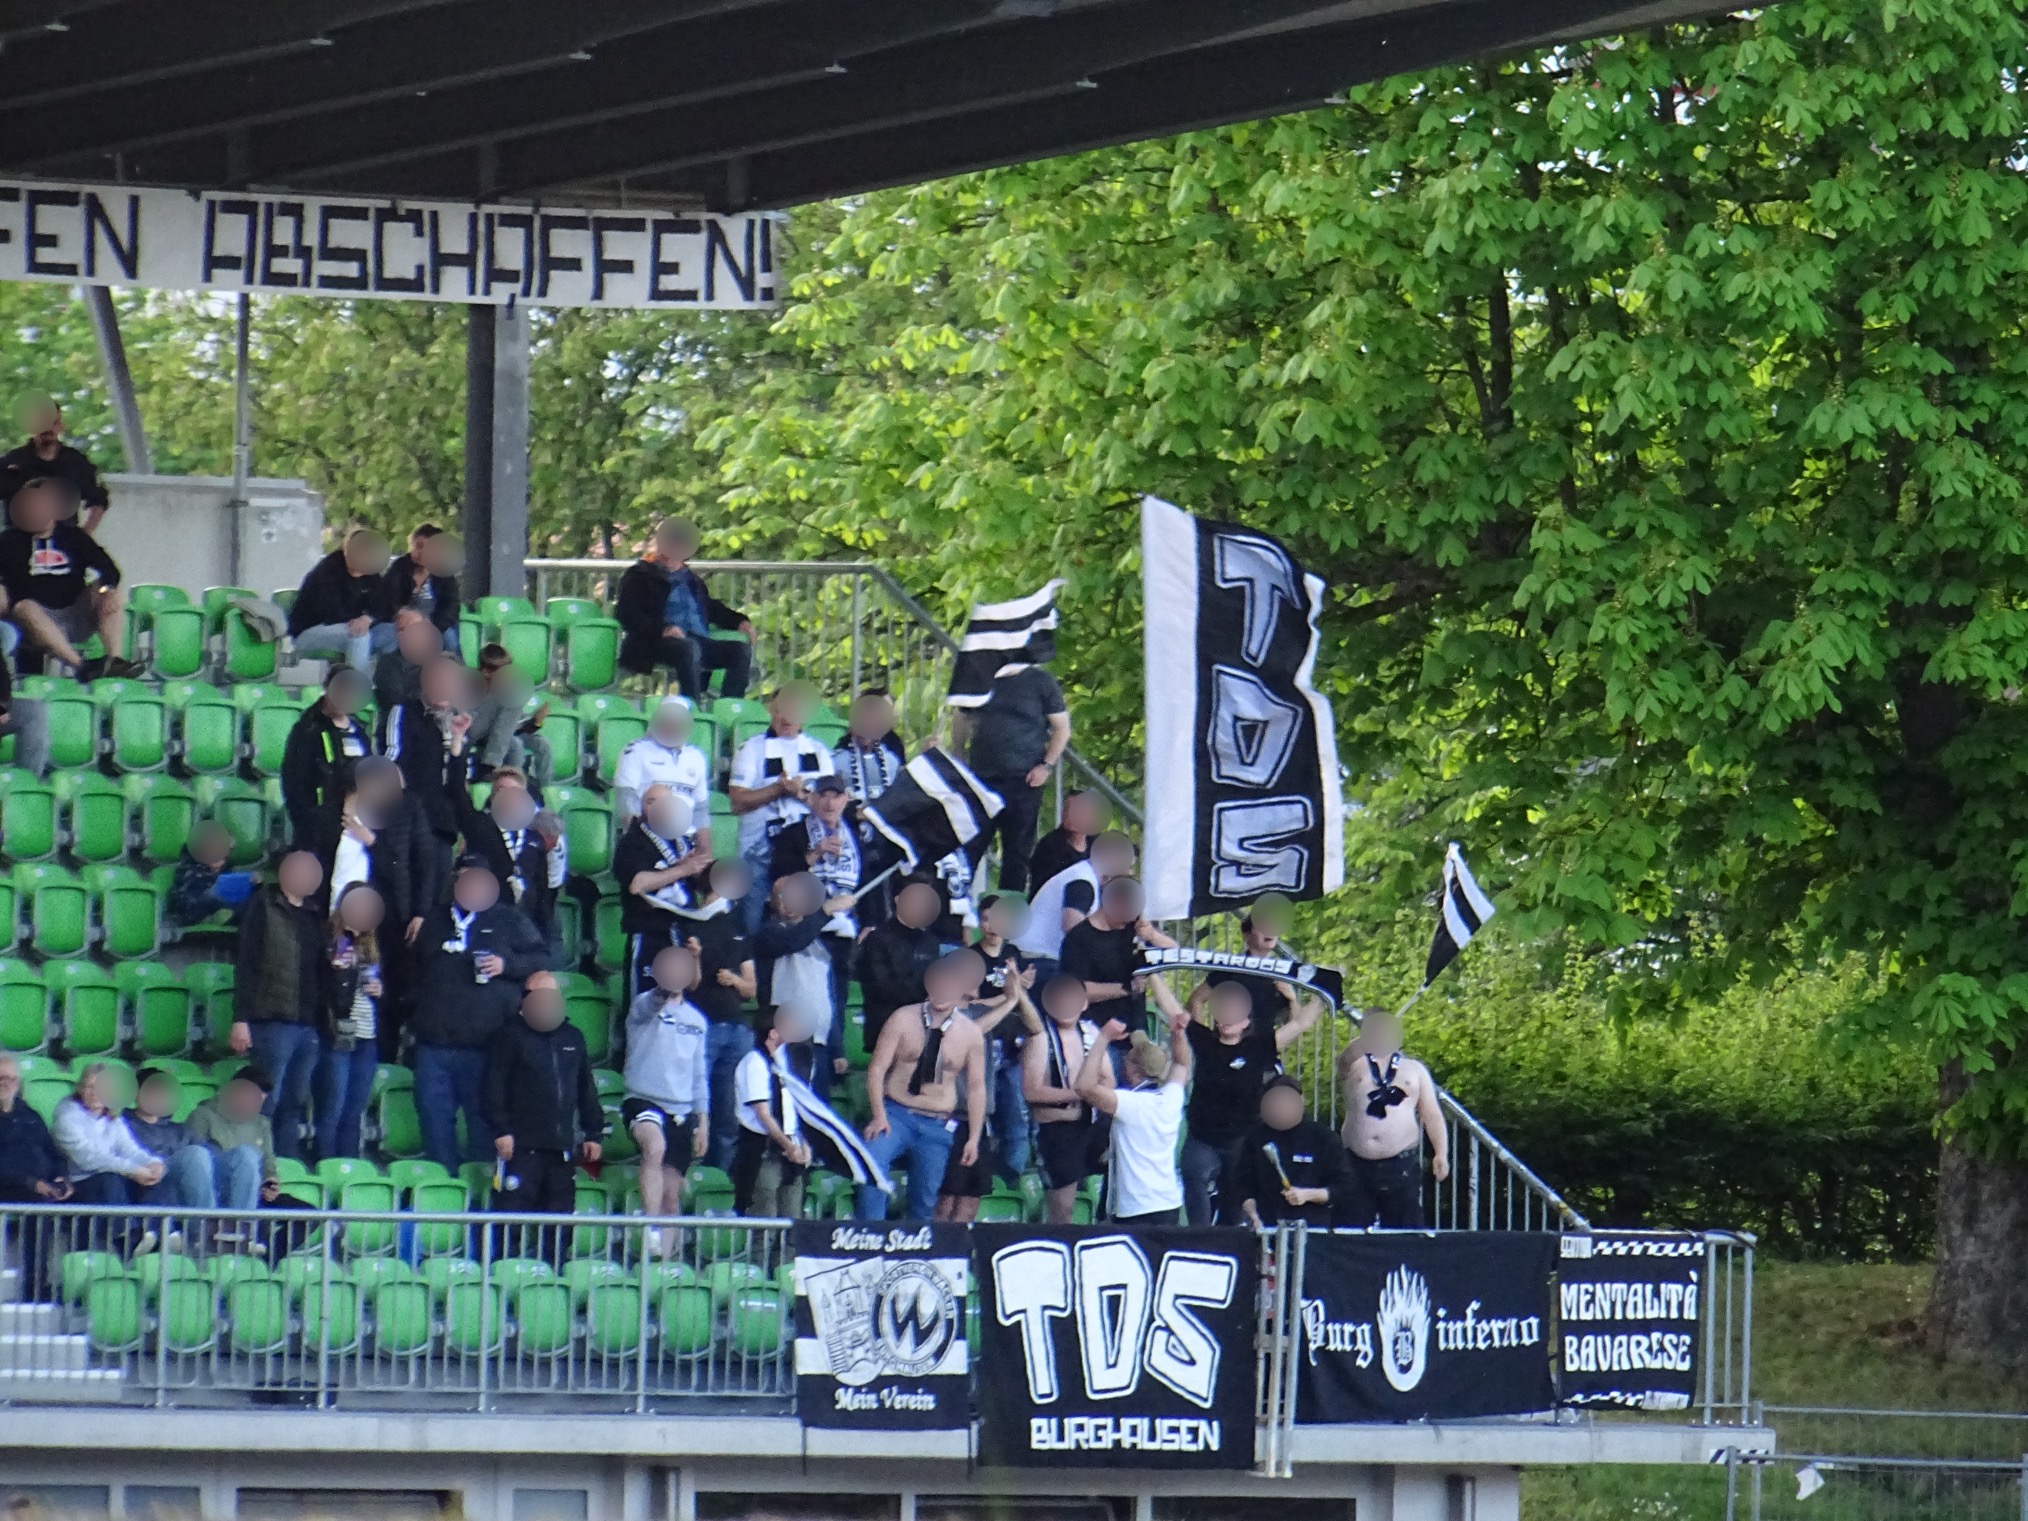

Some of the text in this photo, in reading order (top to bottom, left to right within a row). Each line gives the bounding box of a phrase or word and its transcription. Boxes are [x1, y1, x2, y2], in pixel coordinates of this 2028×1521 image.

[202, 198, 773, 301] ABSCHAFFEN!
[1207, 532, 1314, 898] TDS
[831, 1226, 932, 1252] Meine Stadt
[1560, 1269, 1698, 1320] MENTALITÀ
[991, 1234, 1238, 1409] TDS
[1299, 1298, 1375, 1368] Burg
[1436, 1300, 1541, 1351] inferno
[1565, 1332, 1691, 1372] BAVARESE
[834, 1385, 937, 1411] Mein Verein
[1030, 1417, 1220, 1451] BURGHAUSEN
